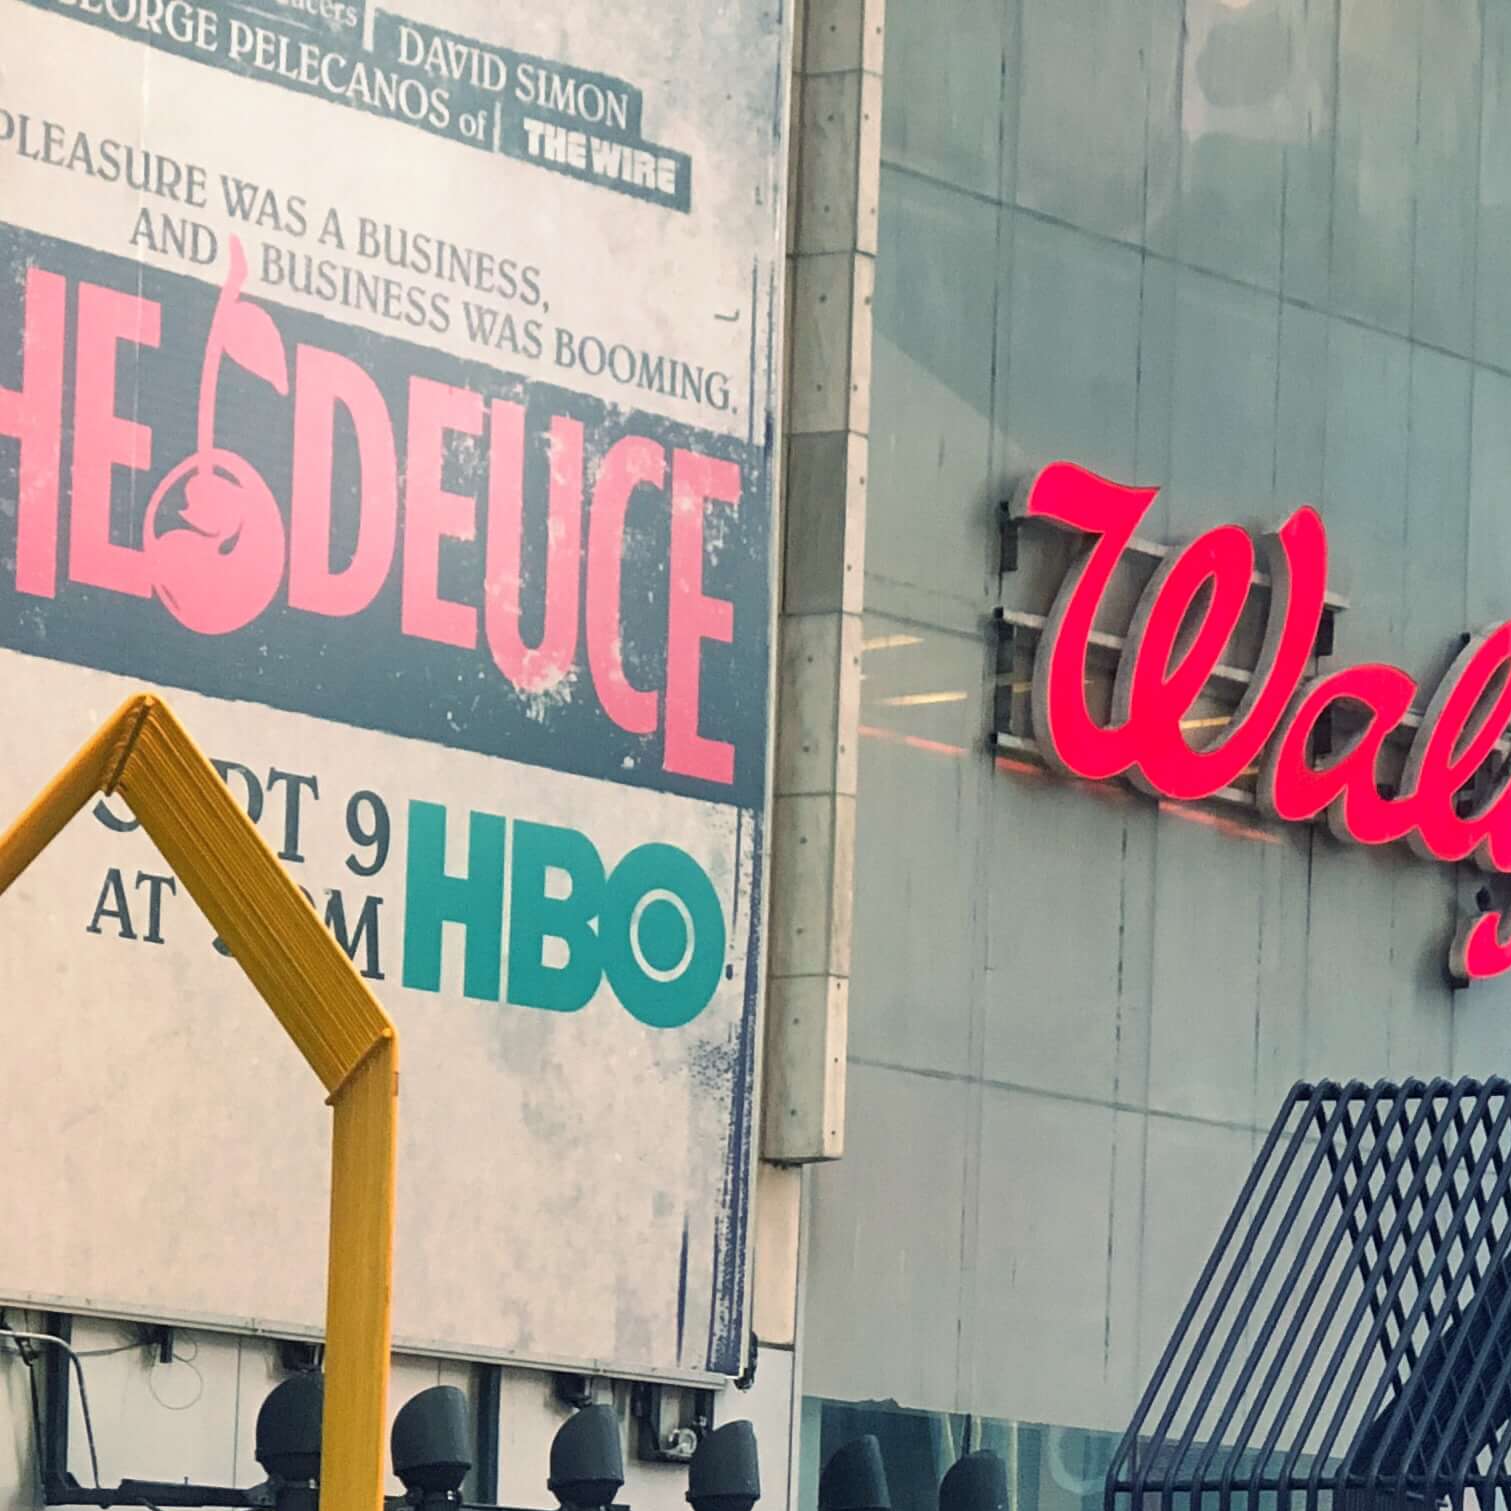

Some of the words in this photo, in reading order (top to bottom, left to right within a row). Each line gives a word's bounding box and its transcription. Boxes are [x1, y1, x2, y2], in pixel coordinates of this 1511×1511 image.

[228, 19, 450, 128] PELECANOS
[458, 110, 487, 141] of
[398, 26, 507, 91] DAVID
[515, 63, 629, 130] SIMON
[523, 117, 588, 170] THE
[589, 136, 677, 195] WIRE
[219, 173, 308, 238] WAS
[317, 207, 345, 250] A
[356, 217, 550, 314] BUSINESS,
[129, 207, 218, 266] AND
[259, 242, 451, 334] BUSINESS
[462, 300, 544, 360] WAS
[554, 327, 739, 416] BOOMING.
[287, 343, 743, 785] DEUCE
[345, 790, 392, 877] 9
[86, 867, 177, 944] AT
[402, 799, 726, 1029] HBO
